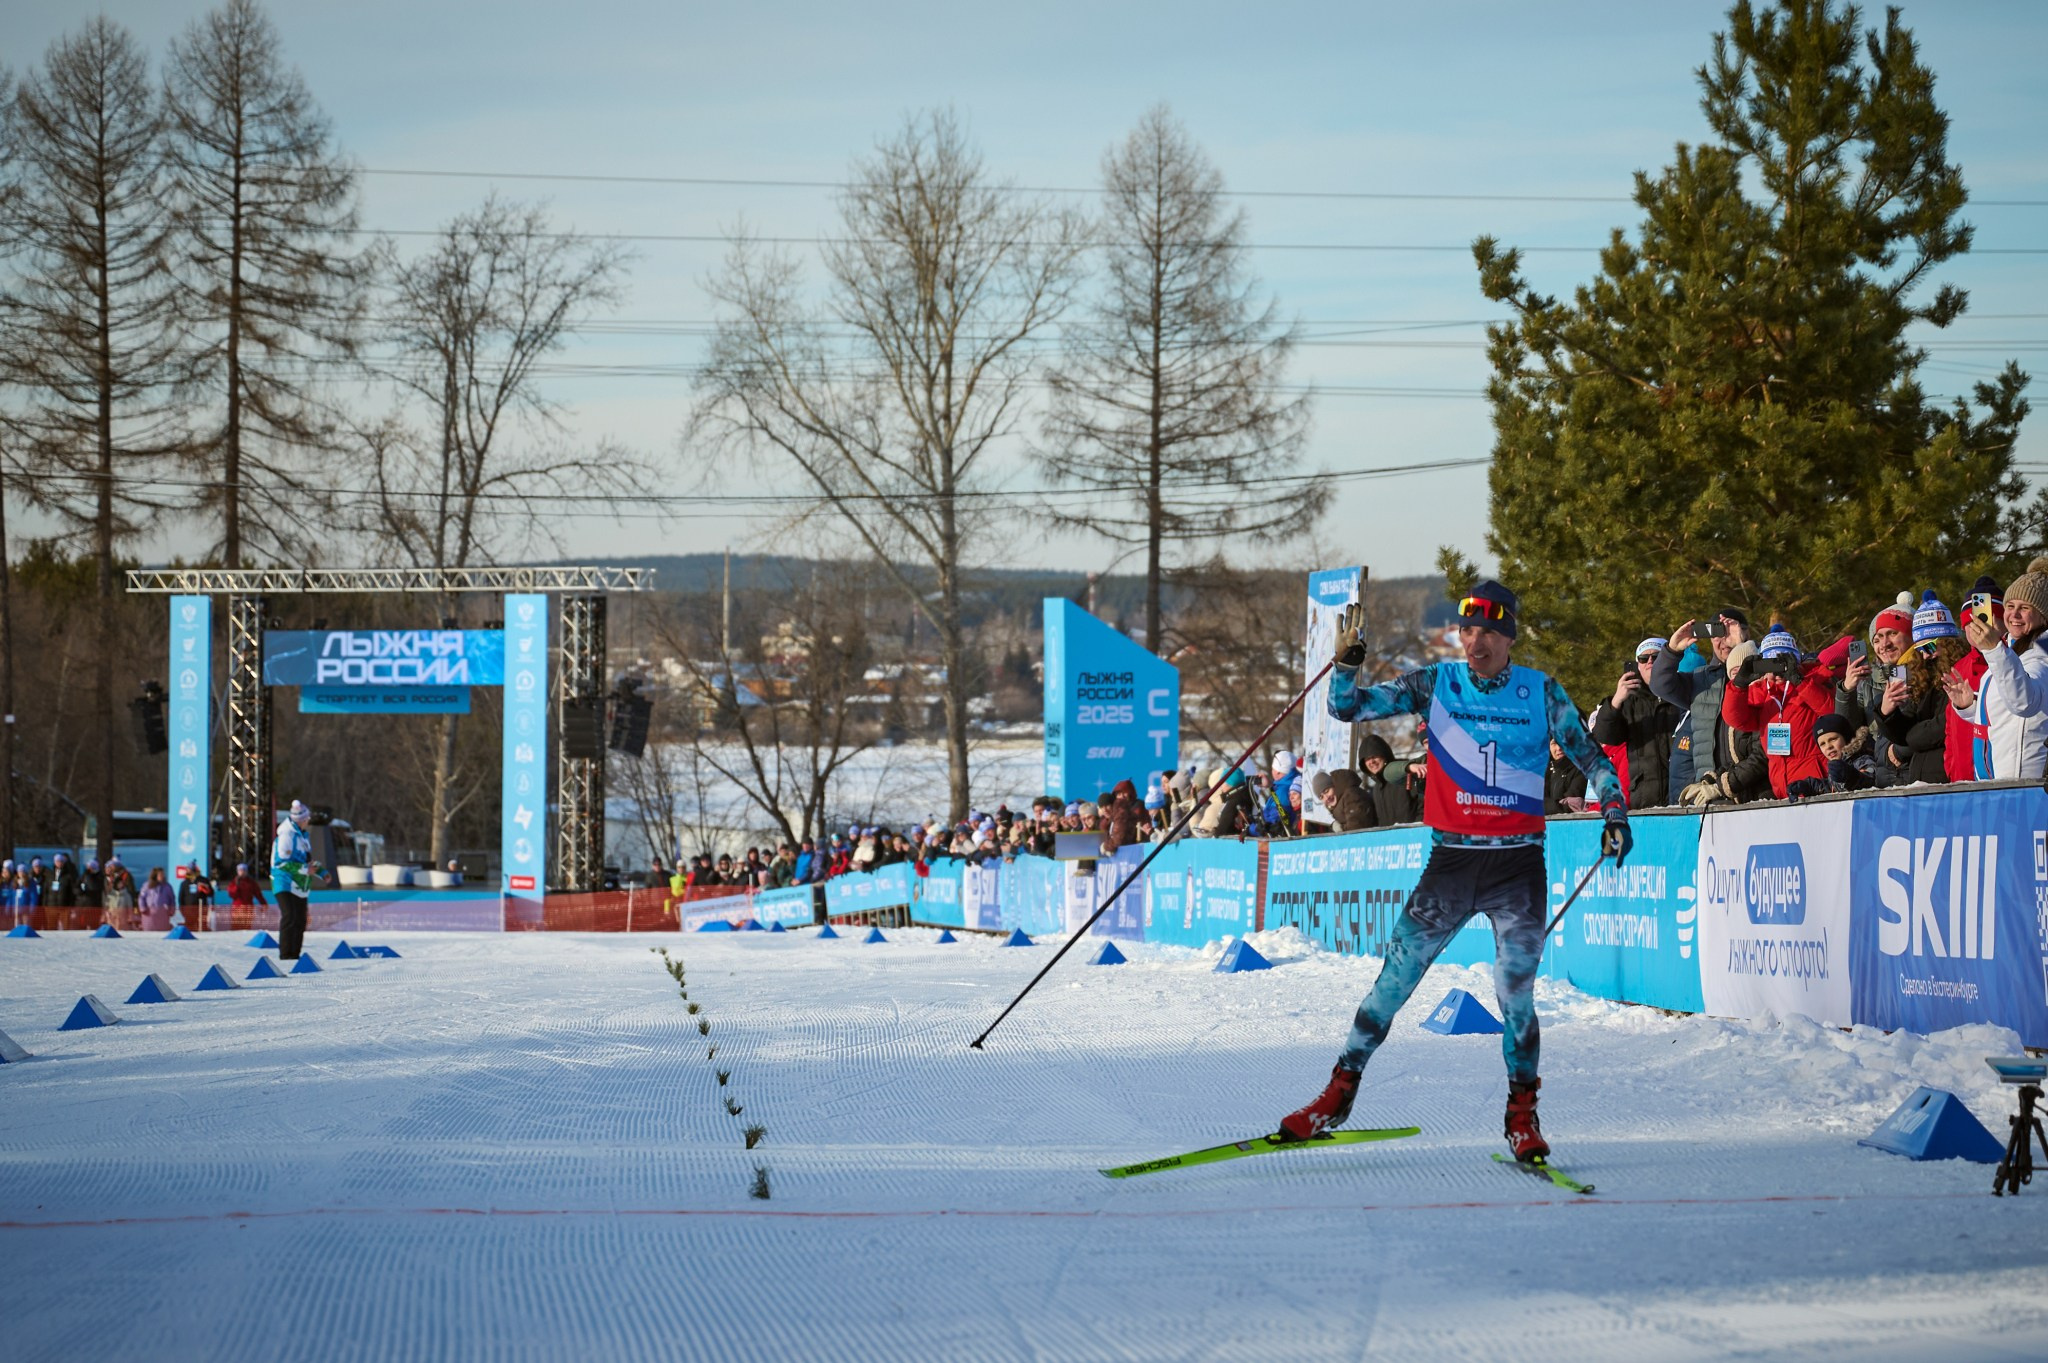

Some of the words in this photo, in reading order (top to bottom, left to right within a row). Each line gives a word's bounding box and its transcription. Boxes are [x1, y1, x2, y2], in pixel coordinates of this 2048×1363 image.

[321, 631, 464, 657] ЛЫЖНЯ
[316, 658, 468, 684] РОССИИ
[1078, 672, 1133, 684] ЛЫЖНЯ
[383, 694, 406, 704] ВСЯ
[1077, 688, 1133, 700] РОССИИ
[1077, 705, 1134, 724] 2025
[1449, 711, 1487, 723] ЛЫЖНЯ
[1491, 715, 1530, 725] РОССИИ
[1479, 740, 1497, 788] 1
[1456, 790, 1472, 805] 80
[1473, 794, 1518, 807] ПОБЕДА!
[1628, 865, 1666, 903] ДИРЕКЦИЯ
[1707, 855, 1742, 917] Ощути
[1750, 854, 1800, 918] будущее
[1728, 938, 1778, 977] лыжного
[1779, 926, 1829, 992] спорта!
[1900, 973, 1927, 998] Сделано
[1928, 980, 1932, 996] в
[1931, 975, 1979, 1005] Екатеринбурге
[1125, 1157, 1182, 1174] FISCHER
